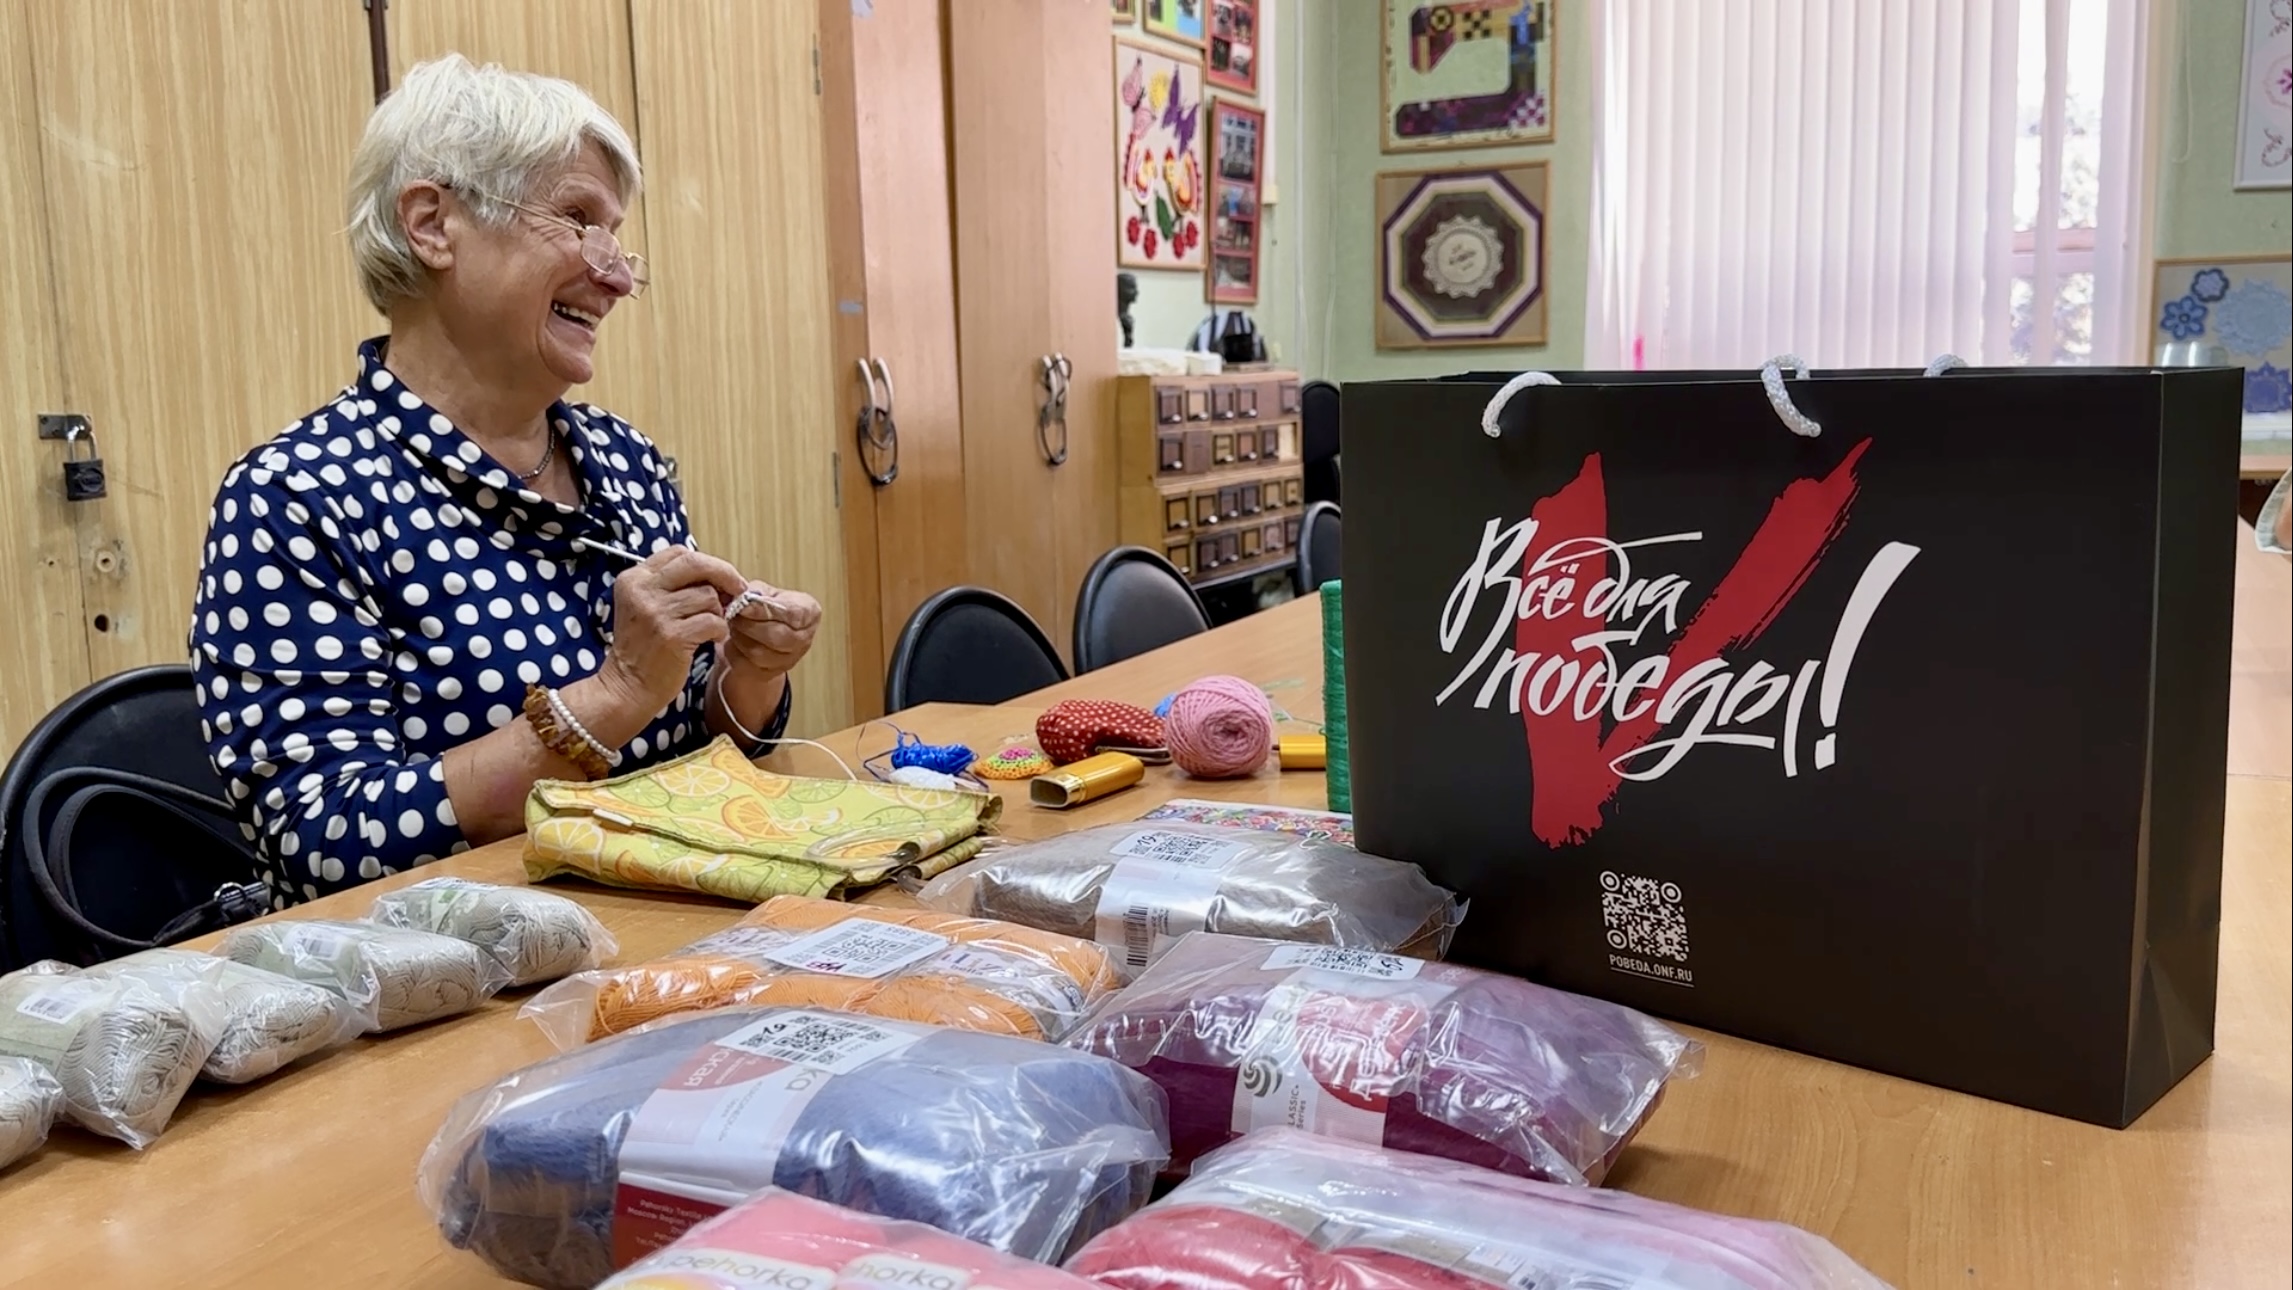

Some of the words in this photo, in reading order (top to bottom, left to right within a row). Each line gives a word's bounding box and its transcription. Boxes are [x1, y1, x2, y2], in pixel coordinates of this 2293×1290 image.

[1435, 517, 1580, 706] Всё
[1528, 531, 1703, 640] для
[1473, 540, 1922, 781] победы!
[1608, 953, 1694, 983] POBEDA.ONF.RU
